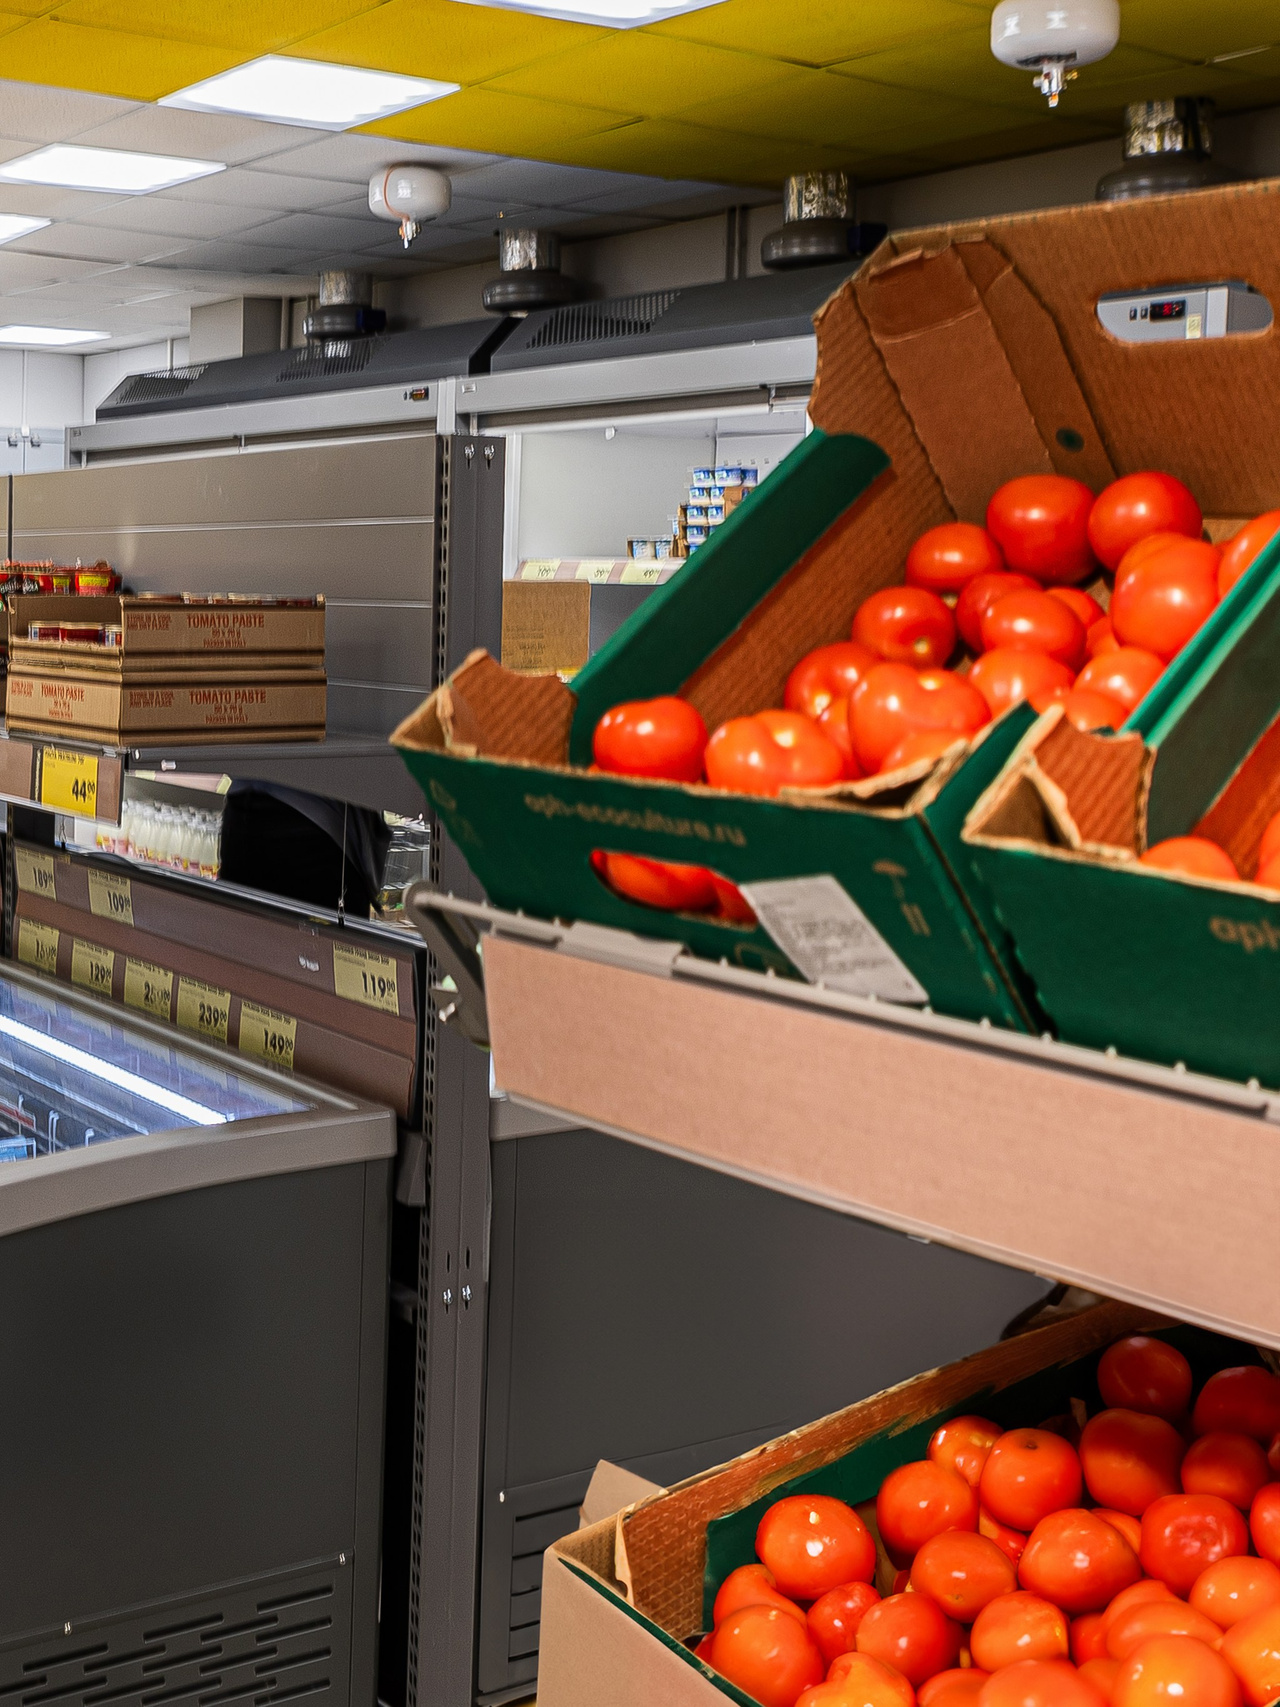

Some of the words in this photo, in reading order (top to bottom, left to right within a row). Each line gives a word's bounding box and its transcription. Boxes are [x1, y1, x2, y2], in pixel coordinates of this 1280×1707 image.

[187, 614, 229, 628] TOMATO
[41, 683, 65, 700] TOMATO
[66, 686, 85, 702] PASTE
[189, 690, 231, 705] TOMATO
